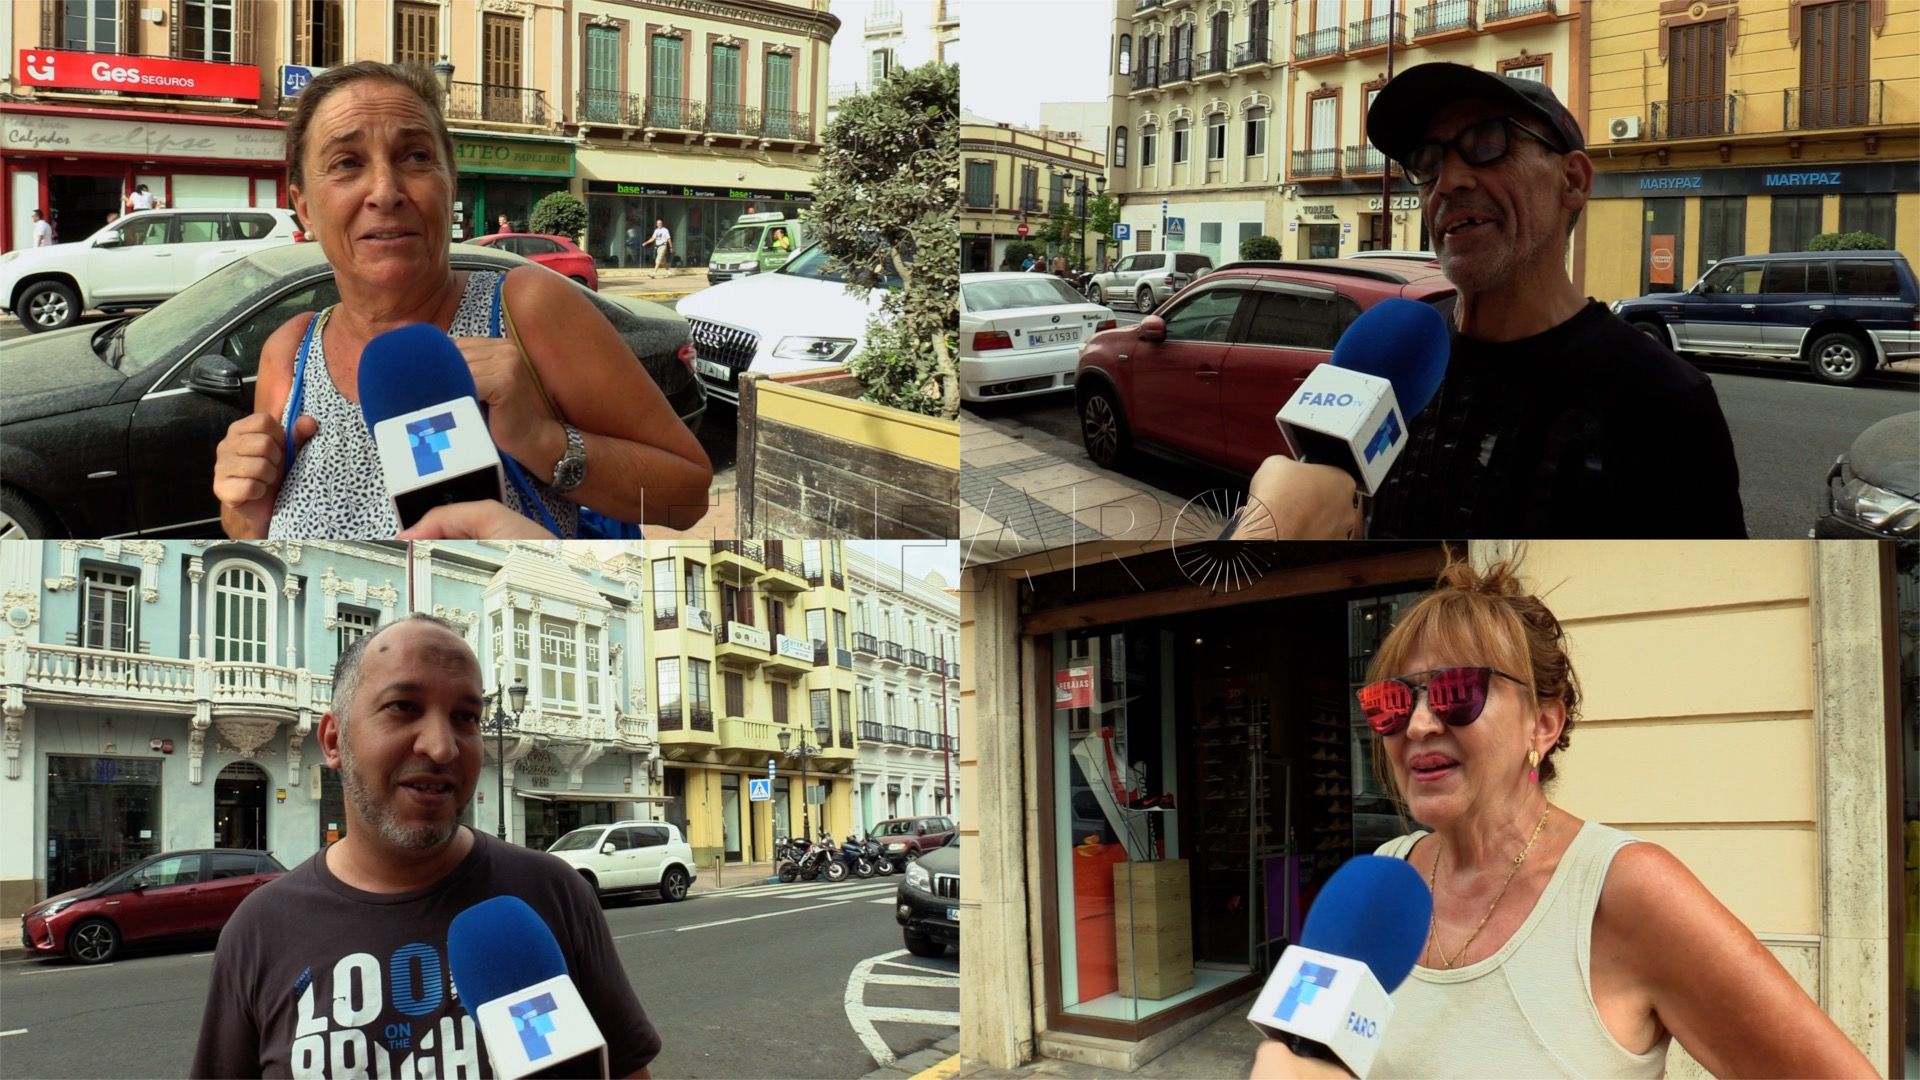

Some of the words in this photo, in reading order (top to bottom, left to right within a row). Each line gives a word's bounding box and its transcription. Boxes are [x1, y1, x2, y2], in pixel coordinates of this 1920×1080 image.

[91, 61, 140, 83] Ges
[141, 74, 195, 88] SEGUROS
[8, 129, 70, 148] Calzados
[82, 126, 216, 153] eclipse
[1640, 176, 1701, 190] MARYPAZ
[1765, 171, 1841, 187] MARYPAZ
[1303, 205, 1334, 214] TORRES
[1368, 196, 1420, 211] CAZED
[1298, 391, 1354, 408] FARO
[294, 943, 459, 1039] LOO
[385, 1022, 412, 1039] ON
[1345, 1010, 1377, 1039] FARO
[291, 1014, 498, 1080] BRIGH
[388, 1039, 411, 1049] THE
